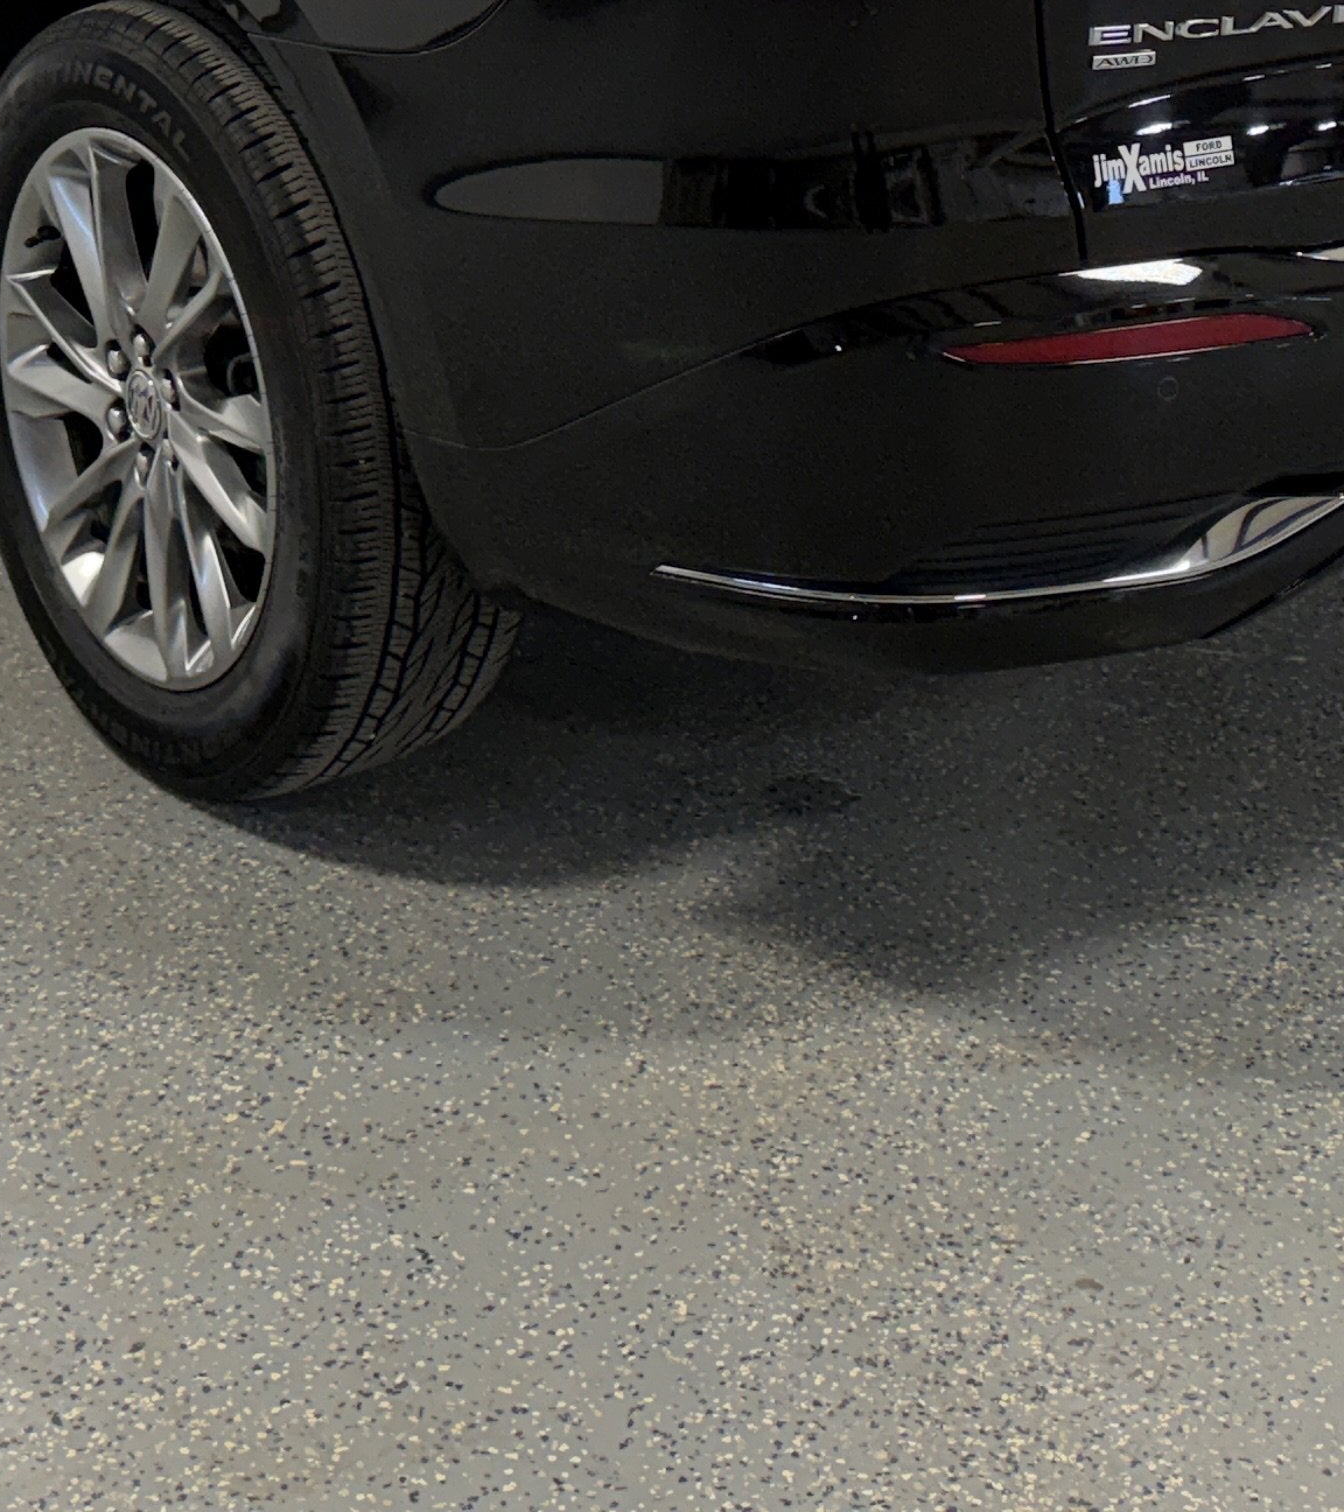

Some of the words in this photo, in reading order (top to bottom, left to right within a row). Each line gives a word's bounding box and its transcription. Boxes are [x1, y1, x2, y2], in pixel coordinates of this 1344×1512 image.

[1096, 52, 1155, 69] AWD
[1195, 139, 1223, 153] FORD
[1189, 153, 1233, 169] LINCOLN
[1148, 172, 1196, 190] Lincoln,
[1197, 170, 1210, 183] IL
